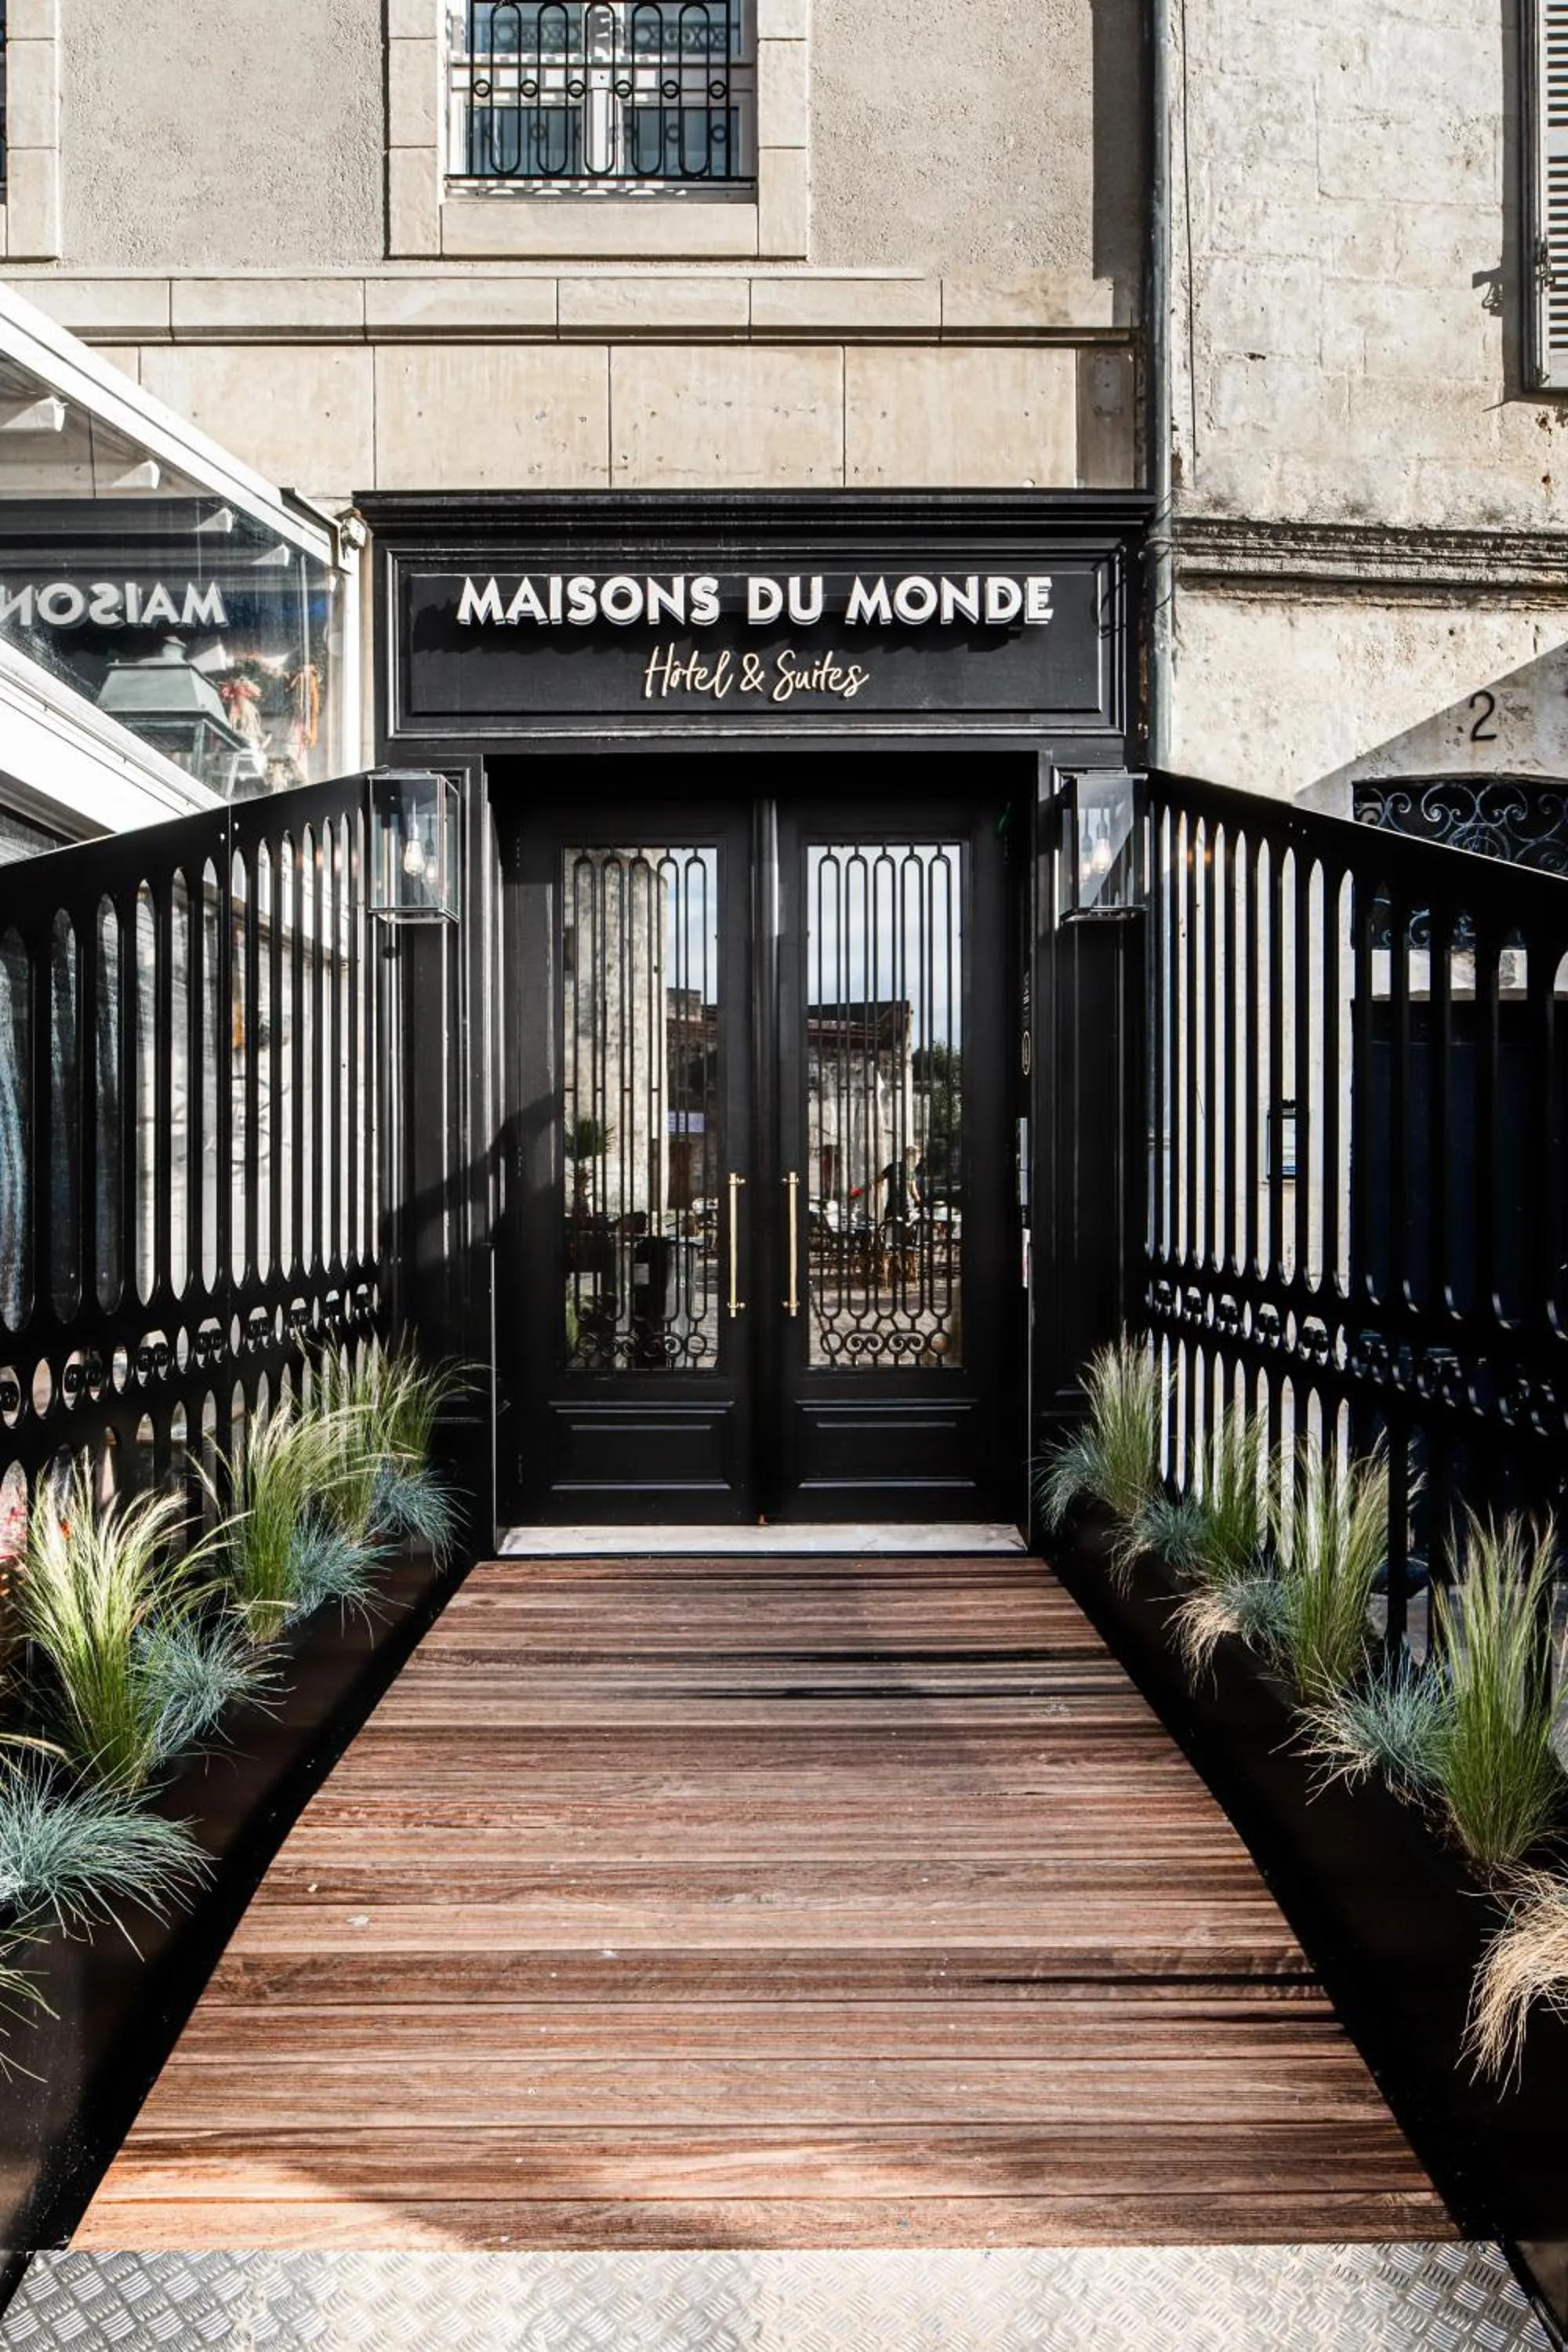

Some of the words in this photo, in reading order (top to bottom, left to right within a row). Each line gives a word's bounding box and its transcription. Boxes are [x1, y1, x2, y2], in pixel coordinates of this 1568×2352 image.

[456, 576, 720, 625] MAISONS
[747, 576, 823, 625] DU
[844, 575, 1054, 625] MONDE
[644, 642, 733, 699] Hôtel
[740, 653, 765, 691] &
[773, 650, 869, 701] Suites
[1469, 689, 1497, 742] 2
